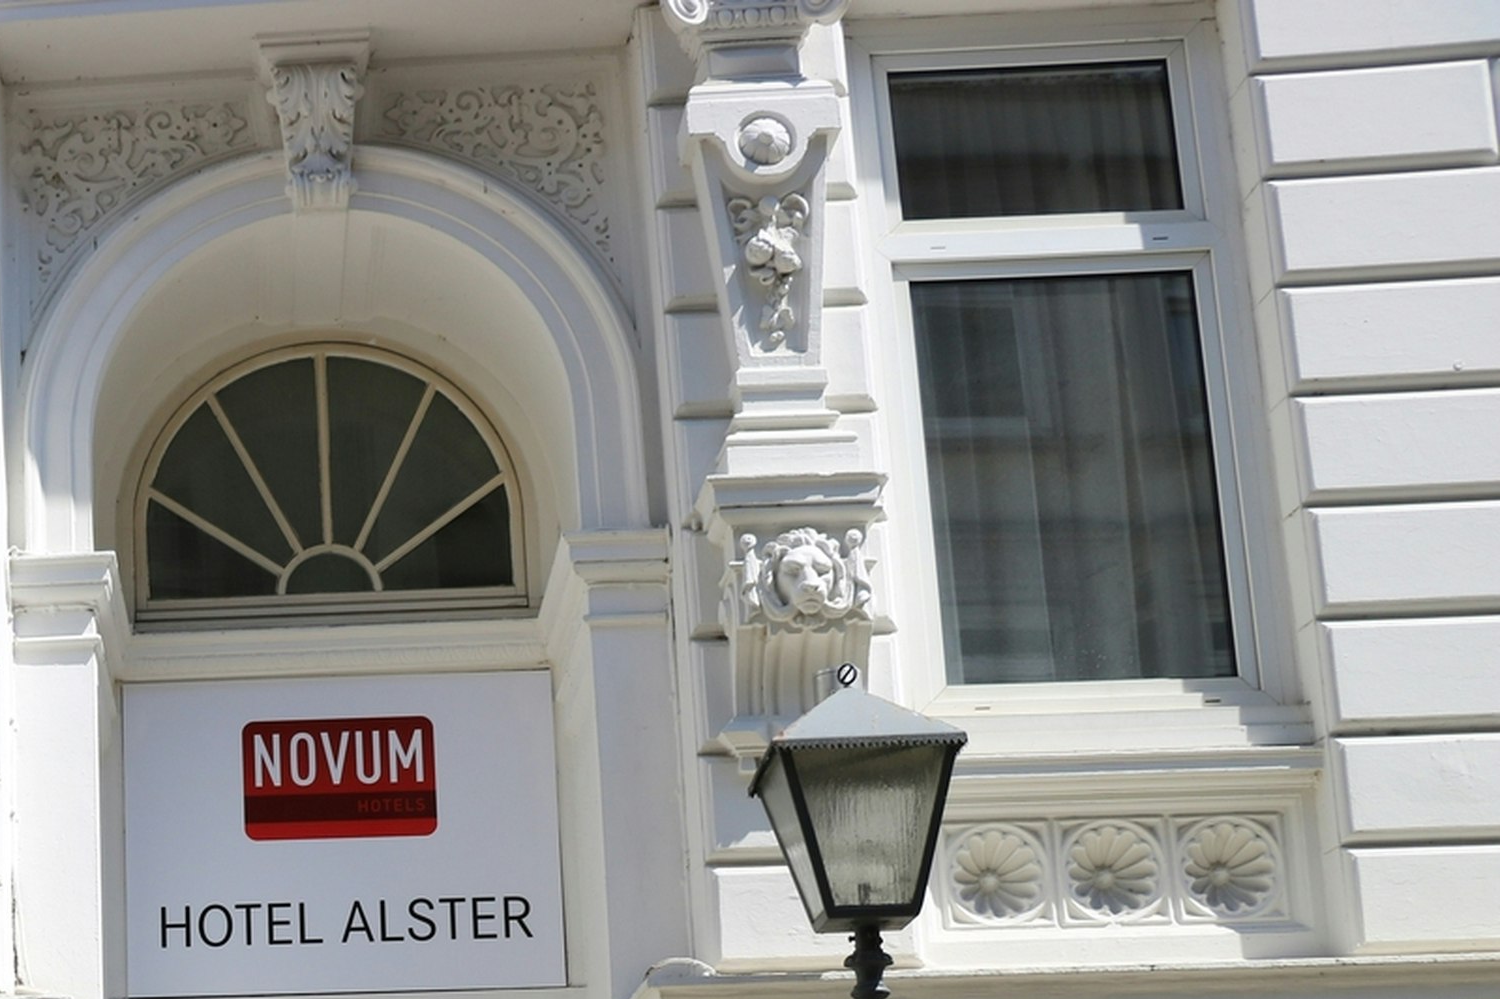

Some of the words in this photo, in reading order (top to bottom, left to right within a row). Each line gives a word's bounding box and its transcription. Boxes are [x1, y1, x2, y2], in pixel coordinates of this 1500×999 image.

[253, 729, 425, 788] NOVUM
[357, 799, 426, 813] HOTELS
[160, 903, 324, 949] HOTEL
[341, 896, 534, 944] ALSTER
